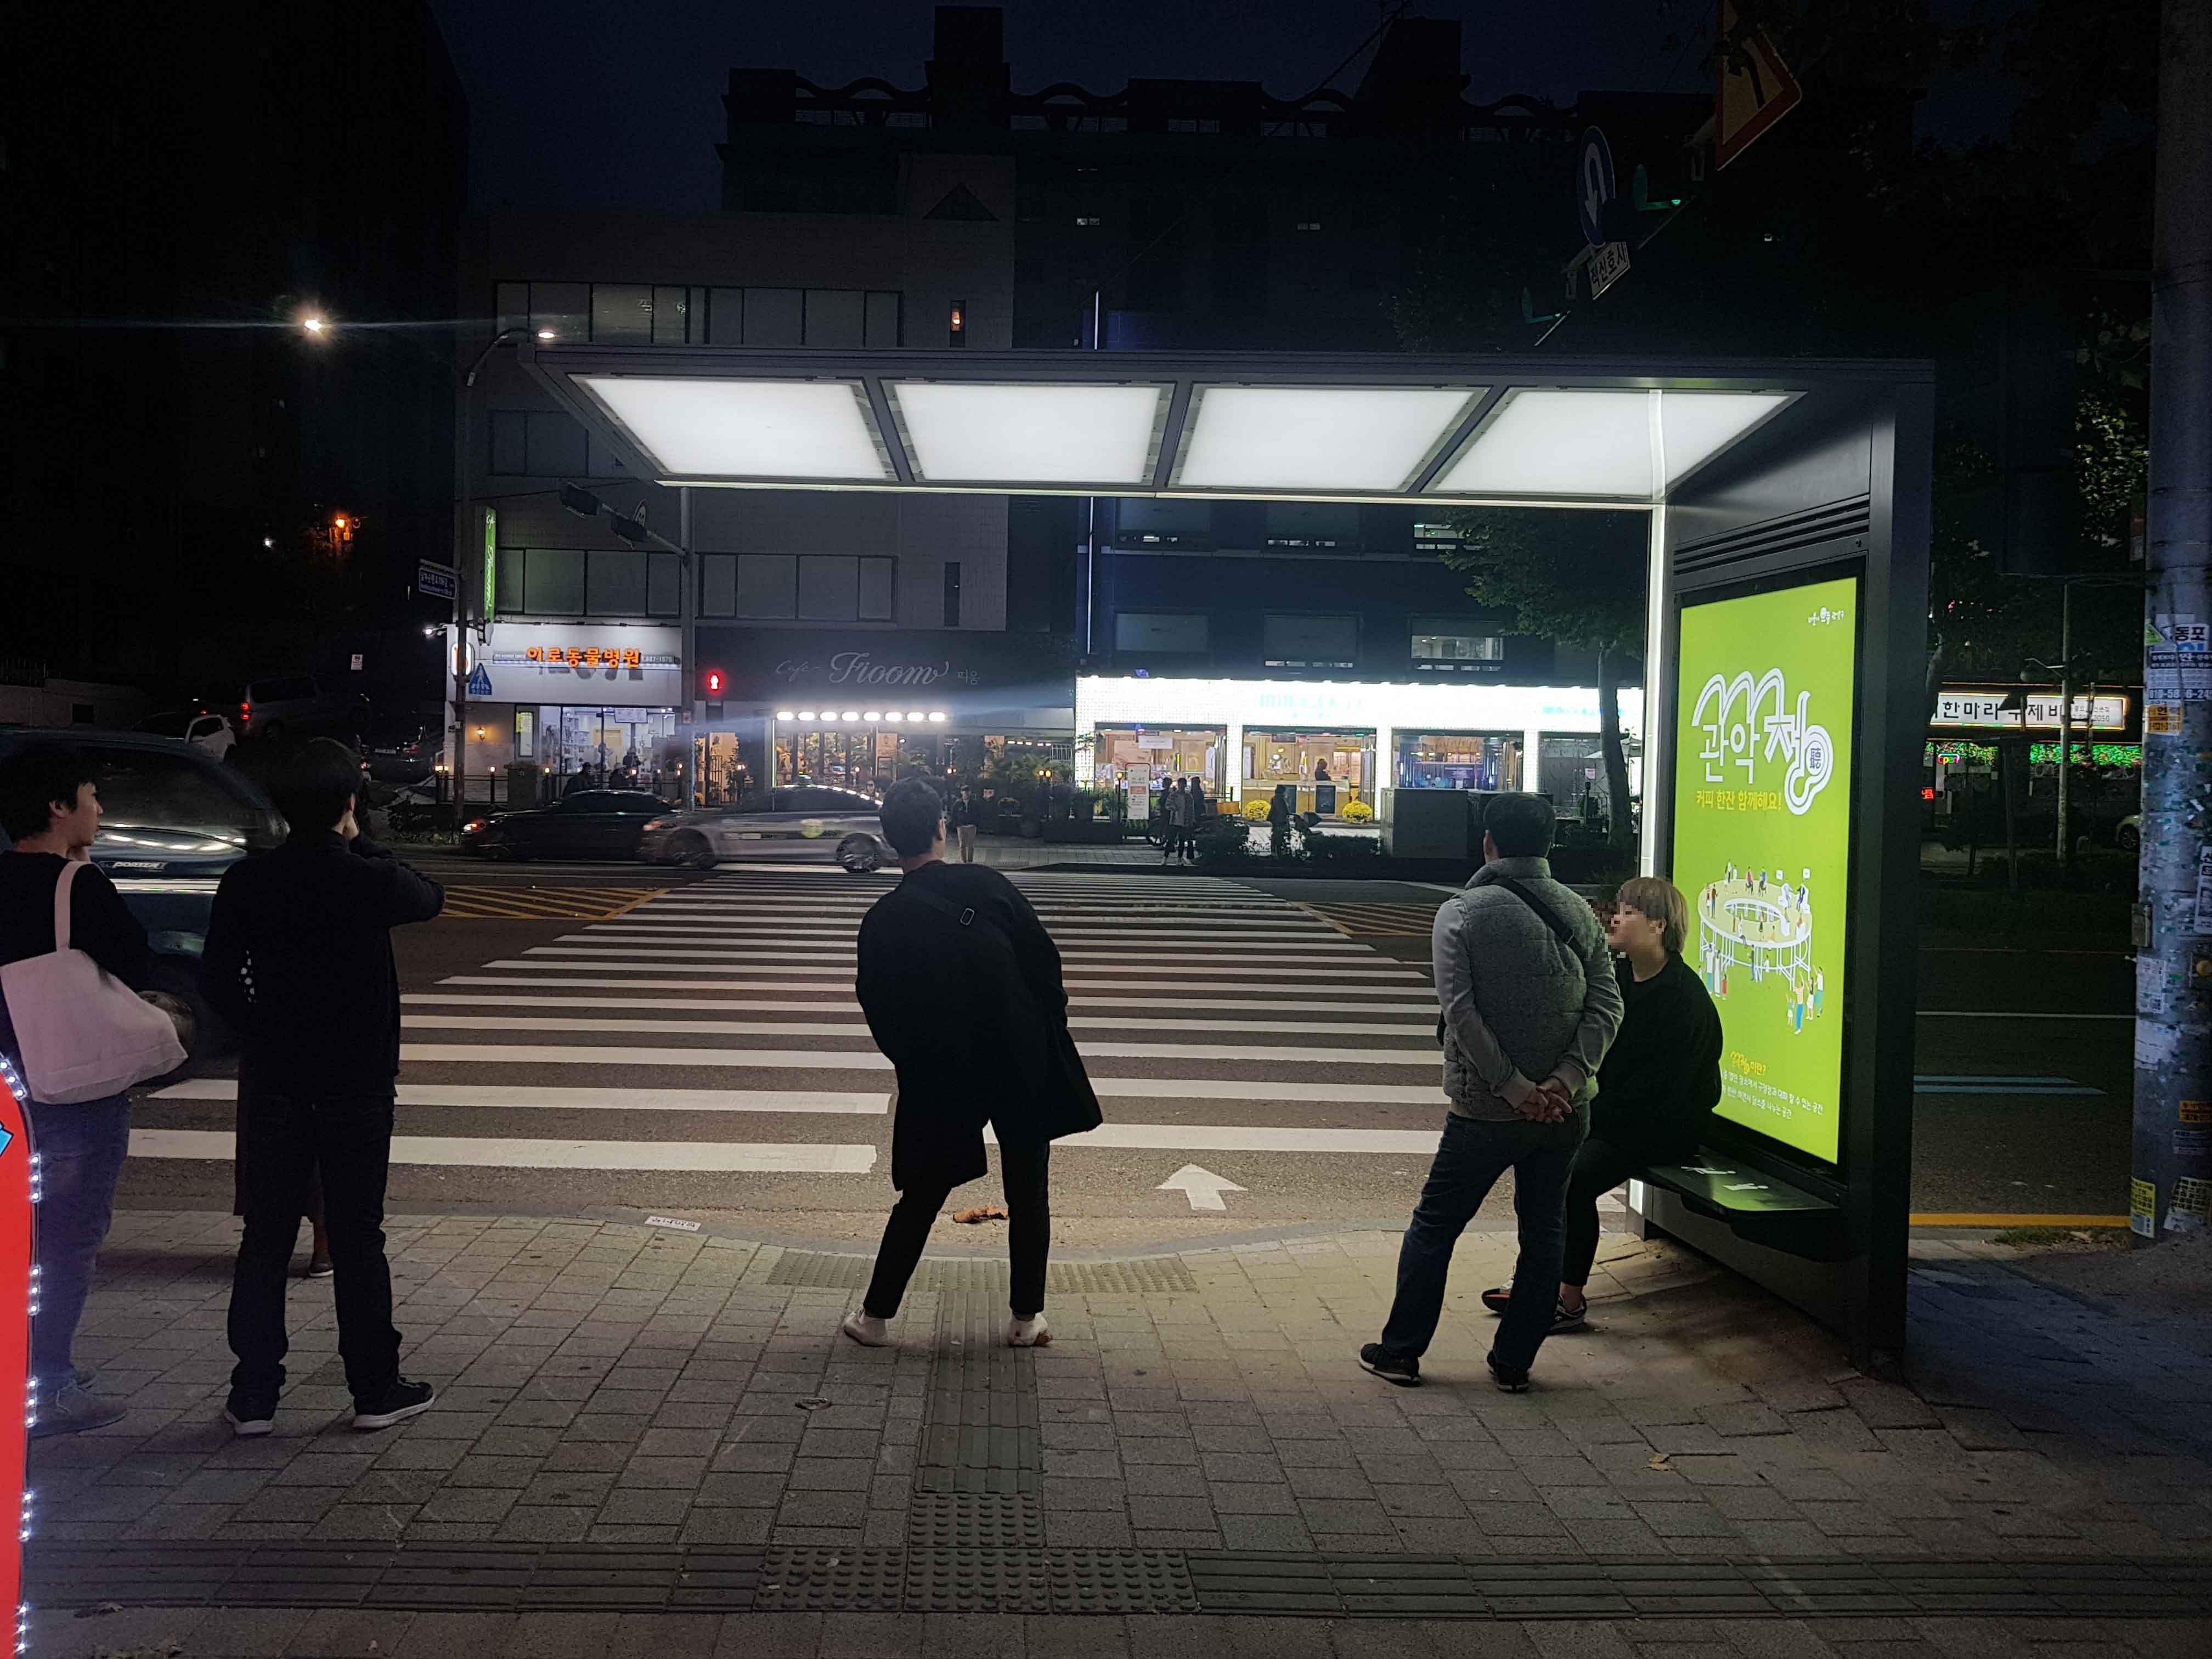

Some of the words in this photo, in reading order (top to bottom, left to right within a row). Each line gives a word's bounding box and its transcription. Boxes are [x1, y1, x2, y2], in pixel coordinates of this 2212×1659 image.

[527, 646, 641, 668] 이로동물병원
[957, 668, 979, 685] 피움
[1935, 702, 1999, 720] 한마리
[1696, 790, 1713, 808] 커피
[1716, 789, 1735, 810] 한잔
[1738, 790, 1782, 811] 함께해요!
